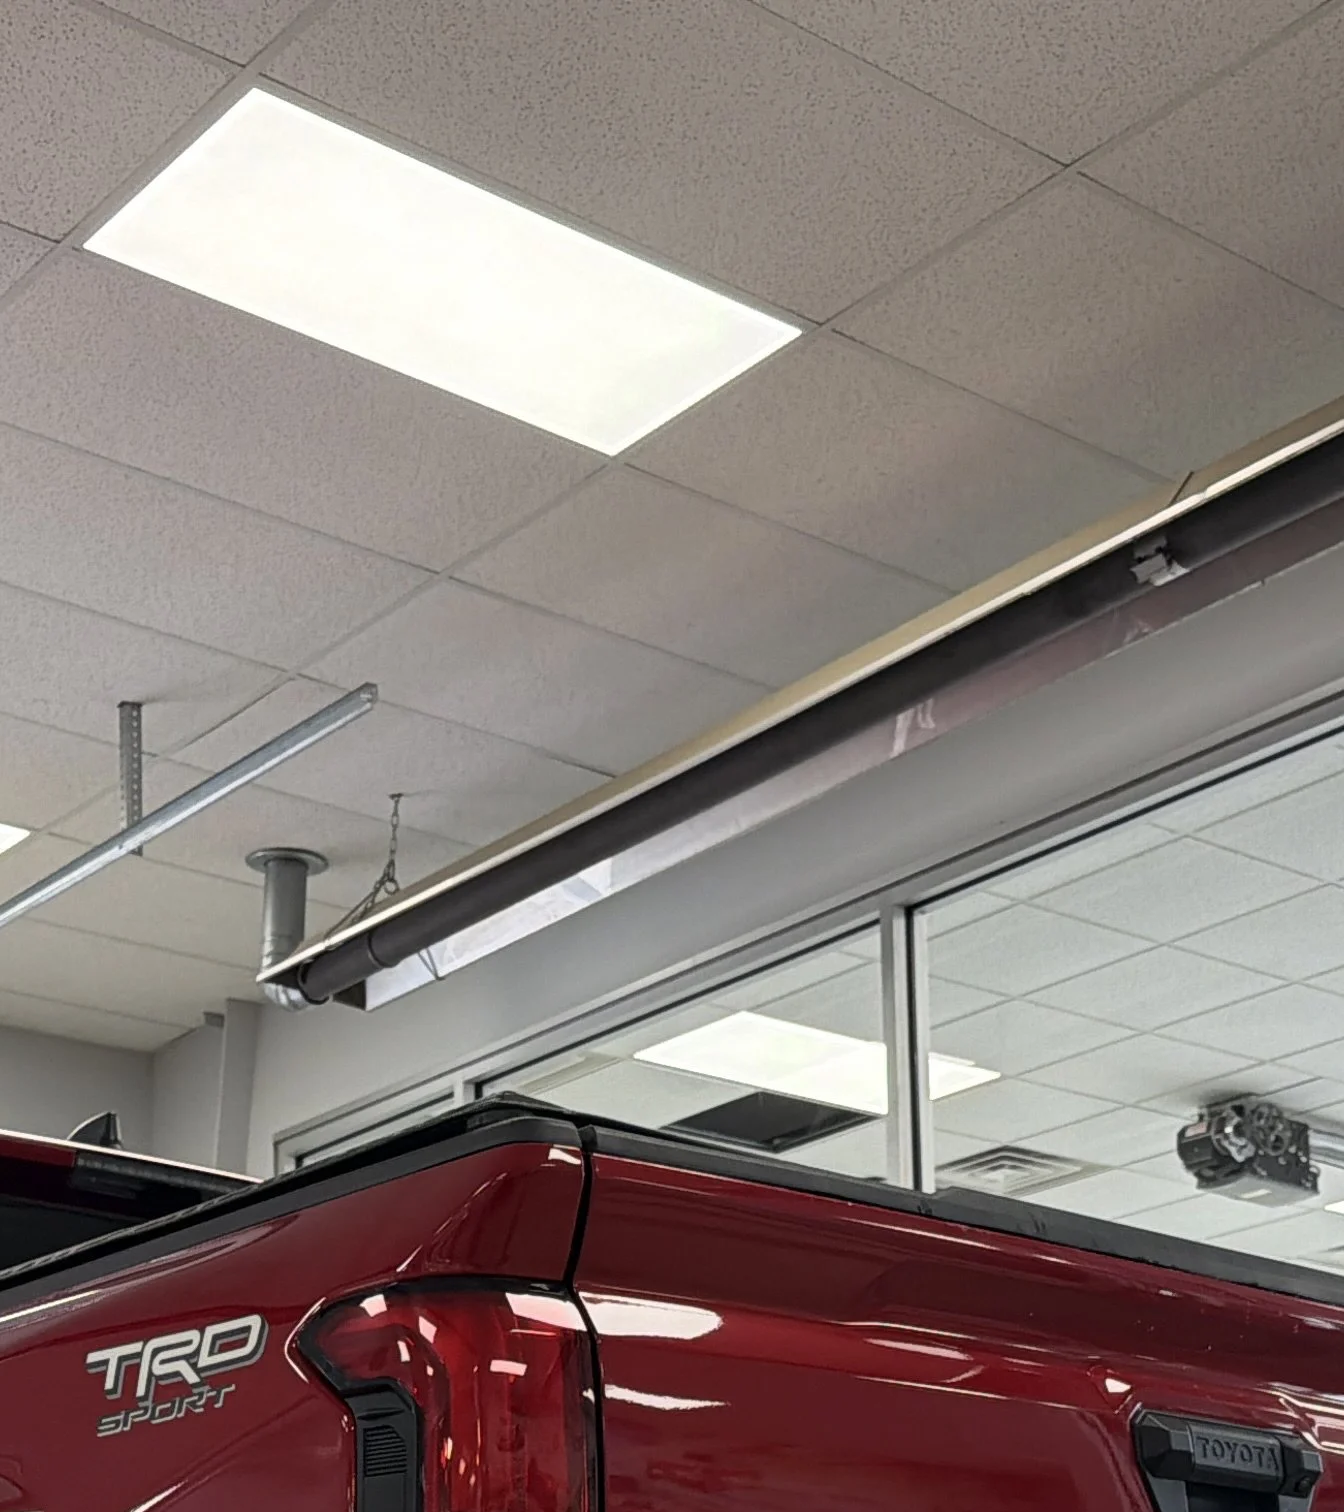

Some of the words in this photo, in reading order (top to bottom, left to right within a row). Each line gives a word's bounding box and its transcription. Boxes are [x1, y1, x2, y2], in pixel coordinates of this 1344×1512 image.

[86, 1313, 268, 1405] TRD
[96, 1384, 236, 1437] SPORT
[1196, 1435, 1280, 1472] TOYOTA
